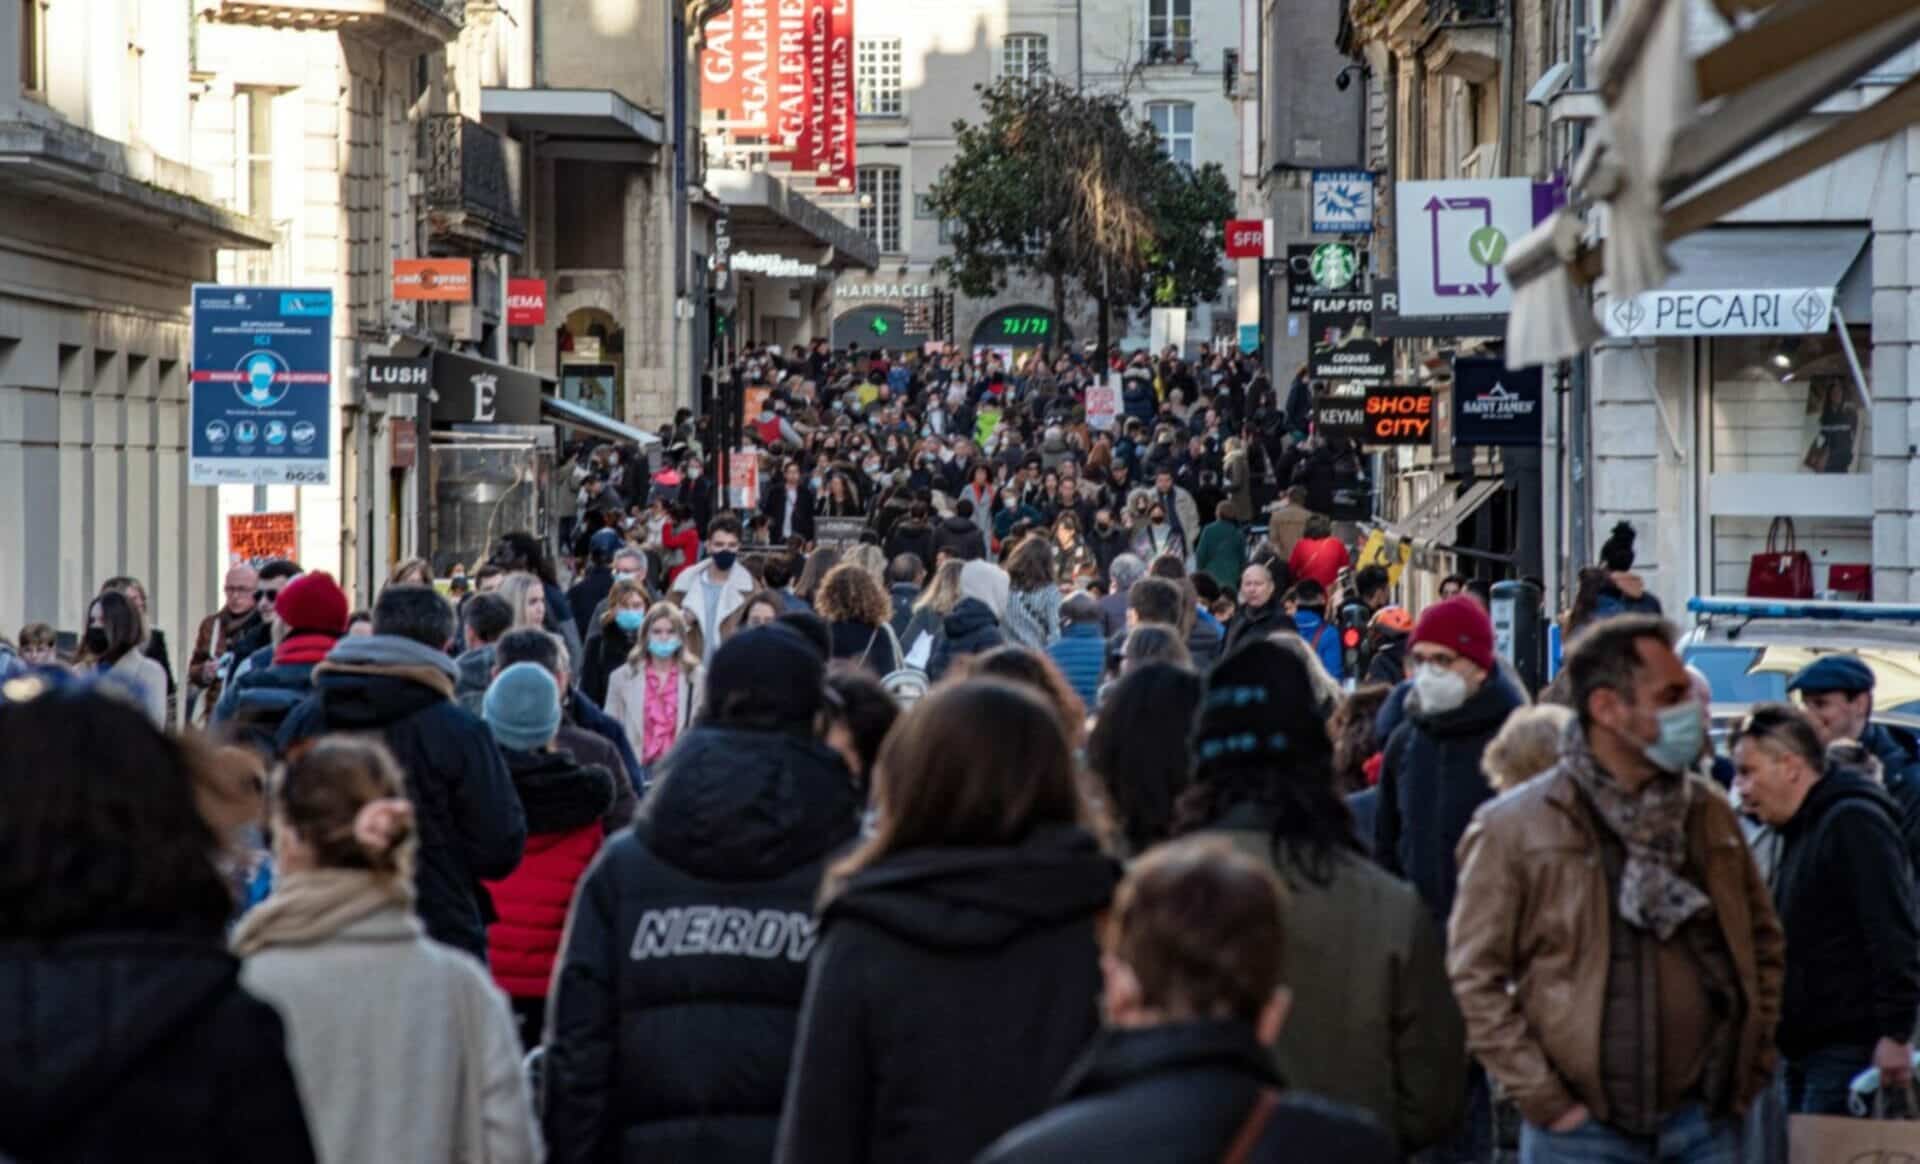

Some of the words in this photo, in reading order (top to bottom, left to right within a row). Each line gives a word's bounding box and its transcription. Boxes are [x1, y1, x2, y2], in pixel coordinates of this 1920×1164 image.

[704, 9, 733, 83] GAL
[1233, 231, 1263, 246] SFR
[836, 284, 929, 297] HARMACIE
[1348, 299, 1373, 312] STO
[1381, 293, 1398, 311] R
[1656, 294, 1780, 329] PECARI
[370, 365, 427, 384] LUSH
[1366, 396, 1432, 414] SHOE
[1320, 408, 1364, 425] KEYMI
[1376, 418, 1430, 437] CITY
[629, 905, 817, 961] NERDY
